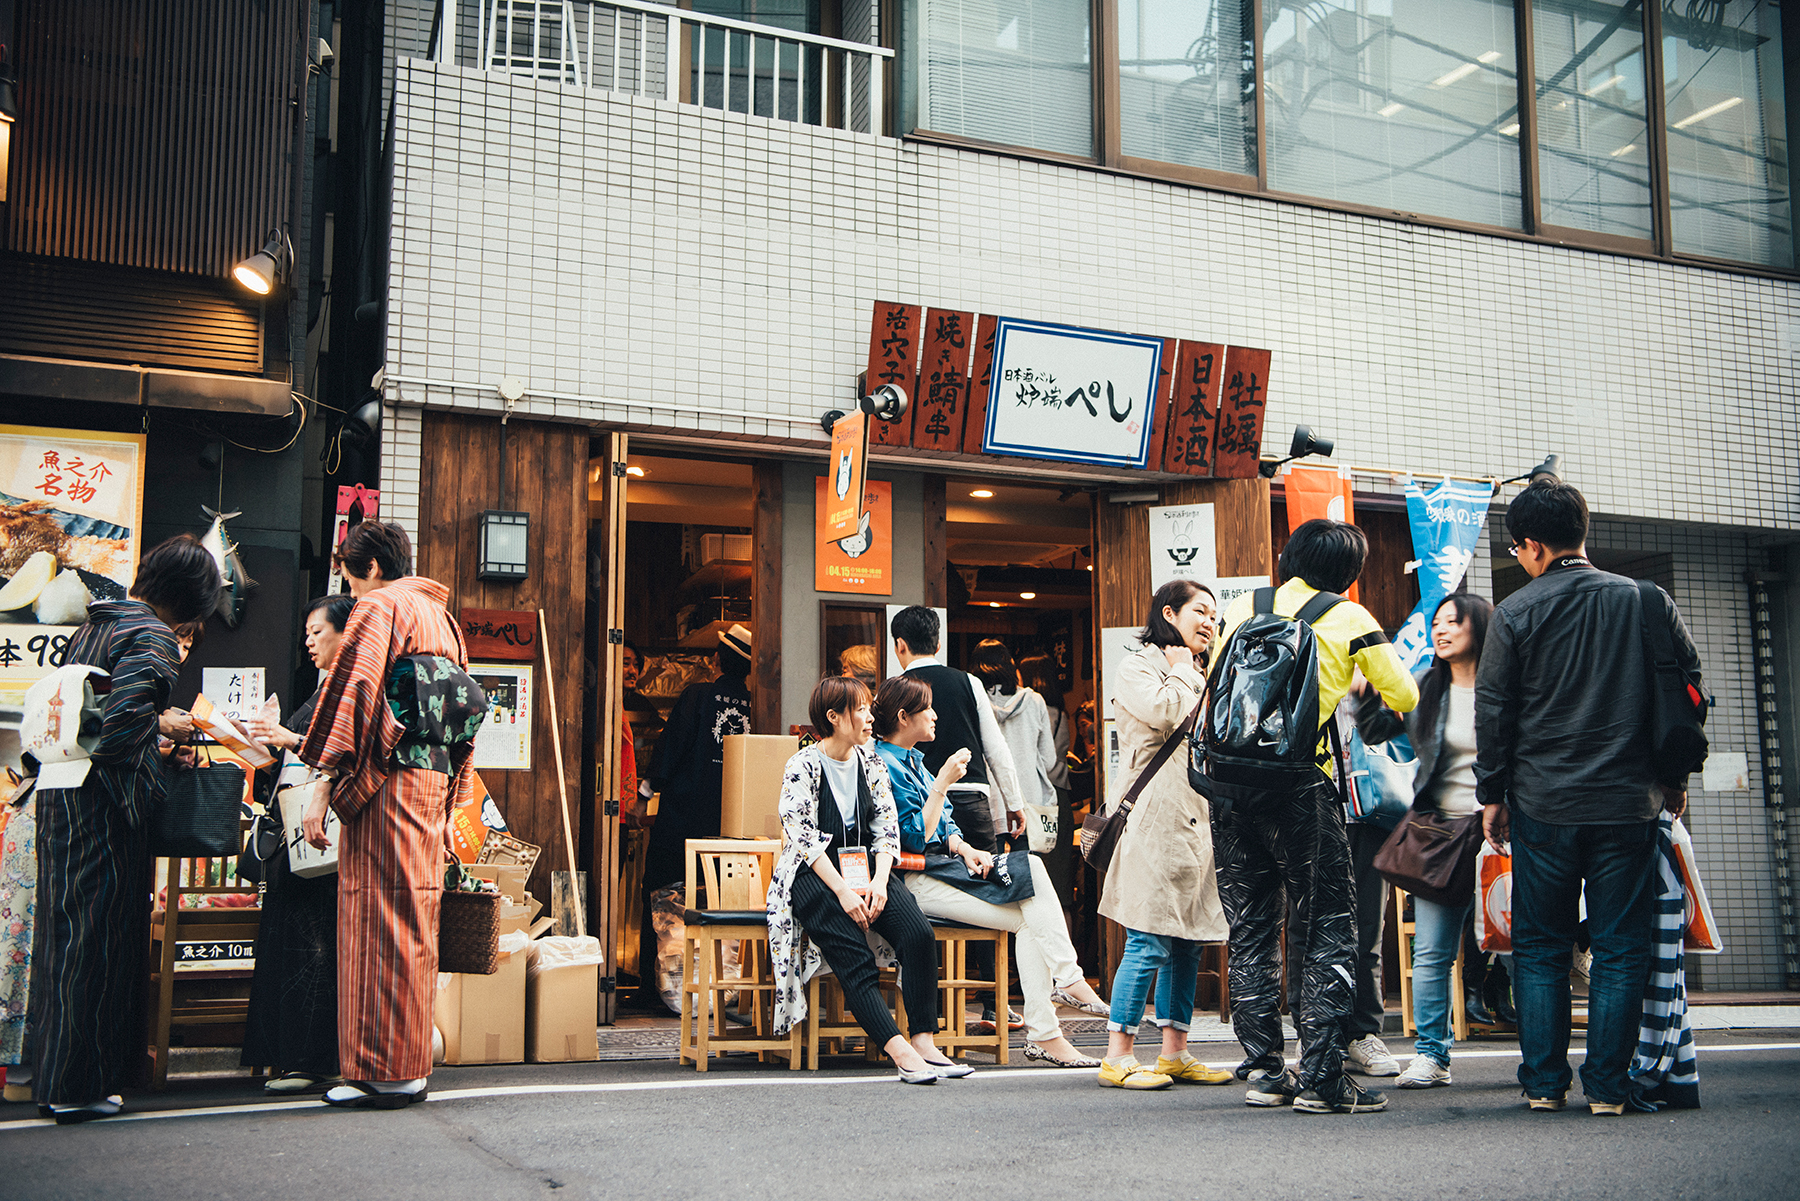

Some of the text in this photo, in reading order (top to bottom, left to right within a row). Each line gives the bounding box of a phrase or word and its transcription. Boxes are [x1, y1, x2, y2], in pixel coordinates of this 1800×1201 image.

[923, 313, 965, 444] 焼き鯖串
[1004, 368, 1057, 384] 日本酒バル
[1174, 353, 1216, 468] 日本酒
[38, 449, 113, 483] 魚之介
[34, 472, 98, 504] 名物
[829, 565, 850, 577] 04.15
[1561, 558, 1589, 566] Canon
[1041, 814, 1058, 834] BEA
[181, 944, 225, 959] 魚之介
